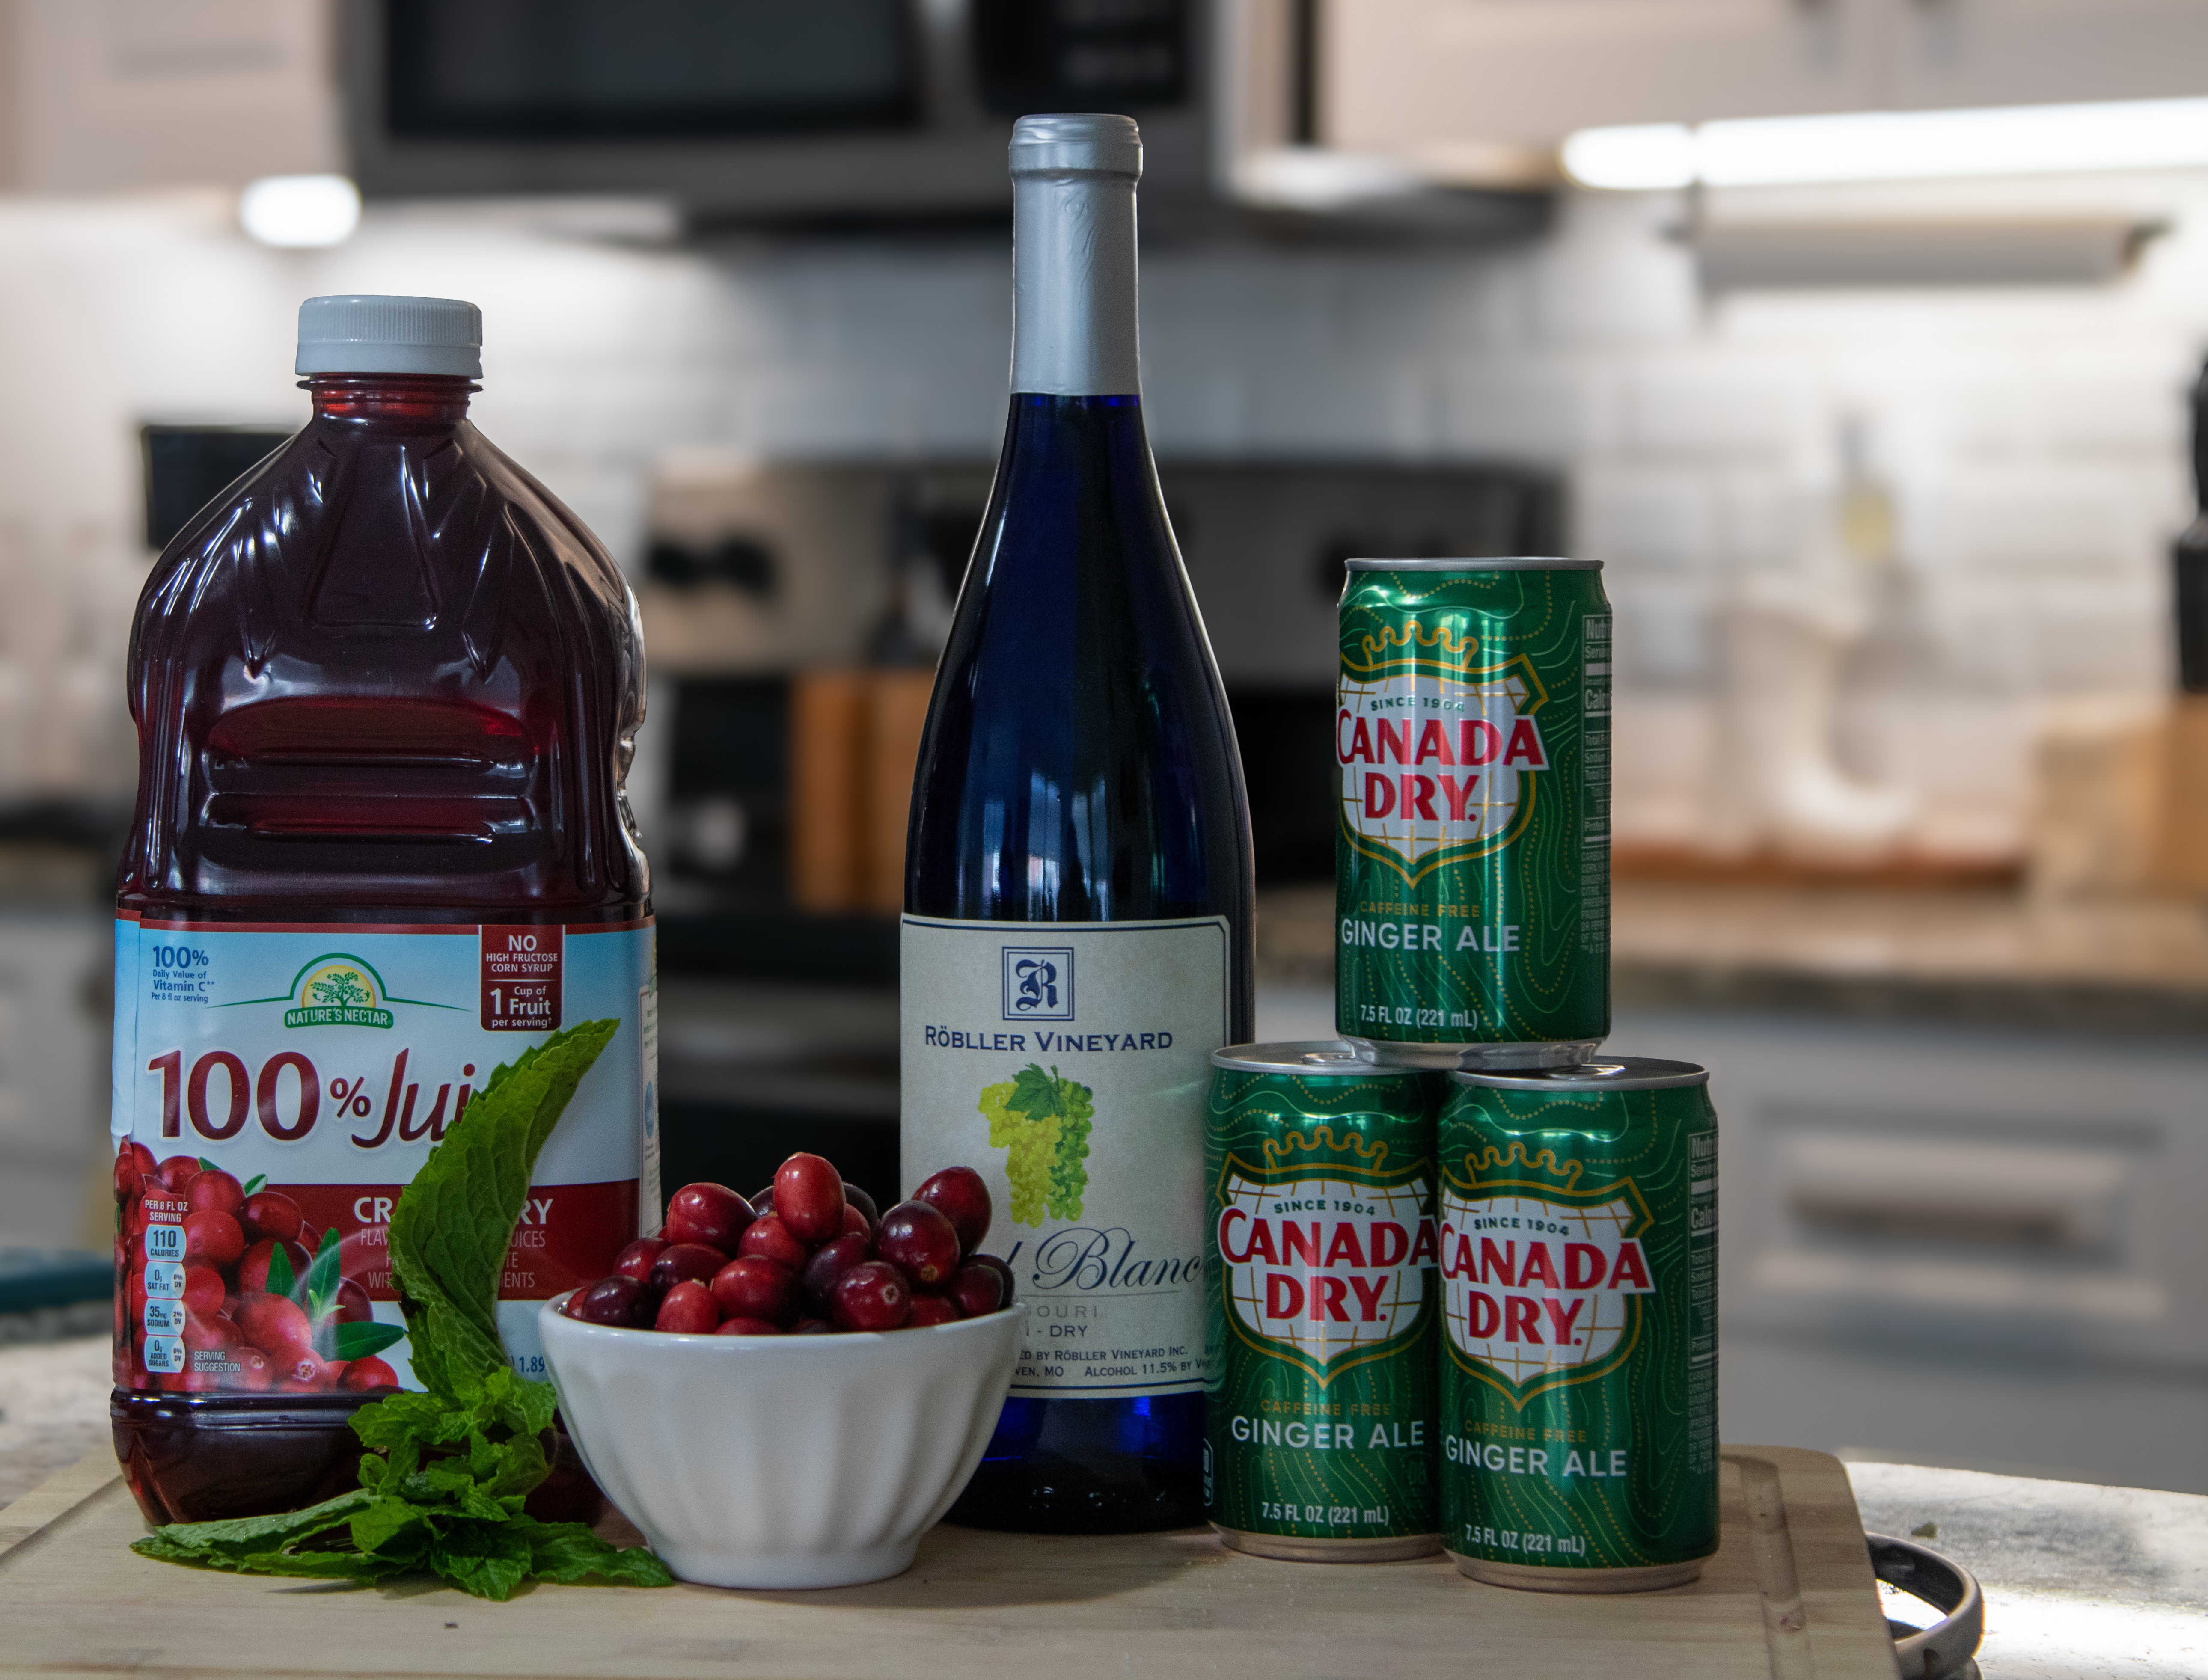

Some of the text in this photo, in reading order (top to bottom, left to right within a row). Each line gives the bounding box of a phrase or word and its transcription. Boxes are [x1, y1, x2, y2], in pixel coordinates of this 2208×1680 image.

[1371, 695, 1464, 713] SINCE 1904
[1338, 709, 1544, 766] CANADA
[1361, 901, 1480, 917] CAFFEINE FREE
[508, 935, 537, 951] NO
[1342, 919, 1520, 952] GINGER ALE
[153, 945, 209, 968] 100%
[486, 953, 558, 962] HIGH FRUCTOSE
[153, 969, 169, 979] Daily
[491, 964, 553, 972] CORN SYRUP
[154, 979, 194, 991] Vitamin
[514, 986, 546, 997] Cup of
[184, 994, 208, 1004] serving
[490, 988, 501, 1015] 1
[509, 997, 550, 1015] Fruit
[288, 1008, 342, 1025] NATURE'S
[492, 1019, 508, 1028] per
[1361, 1004, 1478, 1031] 7.5 FL OZ (221 mL)
[925, 1025, 1173, 1052] RÖBLLER VINEYARD
[145, 1199, 188, 1211] PER 8 FL OZ
[1274, 1199, 1376, 1215] SINCE 1904
[149, 1211, 181, 1223] SERVING
[1474, 1217, 1569, 1236] SINCE 1904
[153, 1229, 176, 1247] 110
[1219, 1208, 1439, 1268] CANADA
[151, 1248, 179, 1257] CALORIES
[1033, 1227, 1201, 1290] Blanc
[1440, 1223, 1651, 1290] CANADA
[147, 1319, 170, 1327] SODIUM
[1050, 1325, 1088, 1337] DRY
[194, 1351, 226, 1361] SERVING
[1037, 1351, 1050, 1360] BY
[1111, 1348, 1165, 1360] VINEYARD
[1169, 1346, 1188, 1356] INC.
[194, 1362, 241, 1372] SUGGESTION
[1045, 1366, 1064, 1377] MO
[1085, 1366, 1138, 1377] ALCOHOL
[1143, 1361, 1177, 1374] 11.5%
[1181, 1361, 1192, 1371] BY
[1260, 1399, 1390, 1416] CAFFEINE FREE
[1232, 1416, 1424, 1449] GINGER ALE
[1465, 1420, 1586, 1443] CAFFEINE FREE
[1446, 1434, 1548, 1475] GINGER
[1563, 1450, 1626, 1477] ALE
[1262, 1502, 1389, 1527] 7.5 FL OZ (221 mL)
[1465, 1523, 1585, 1557] 7.5 FL OZ (221 mL)
